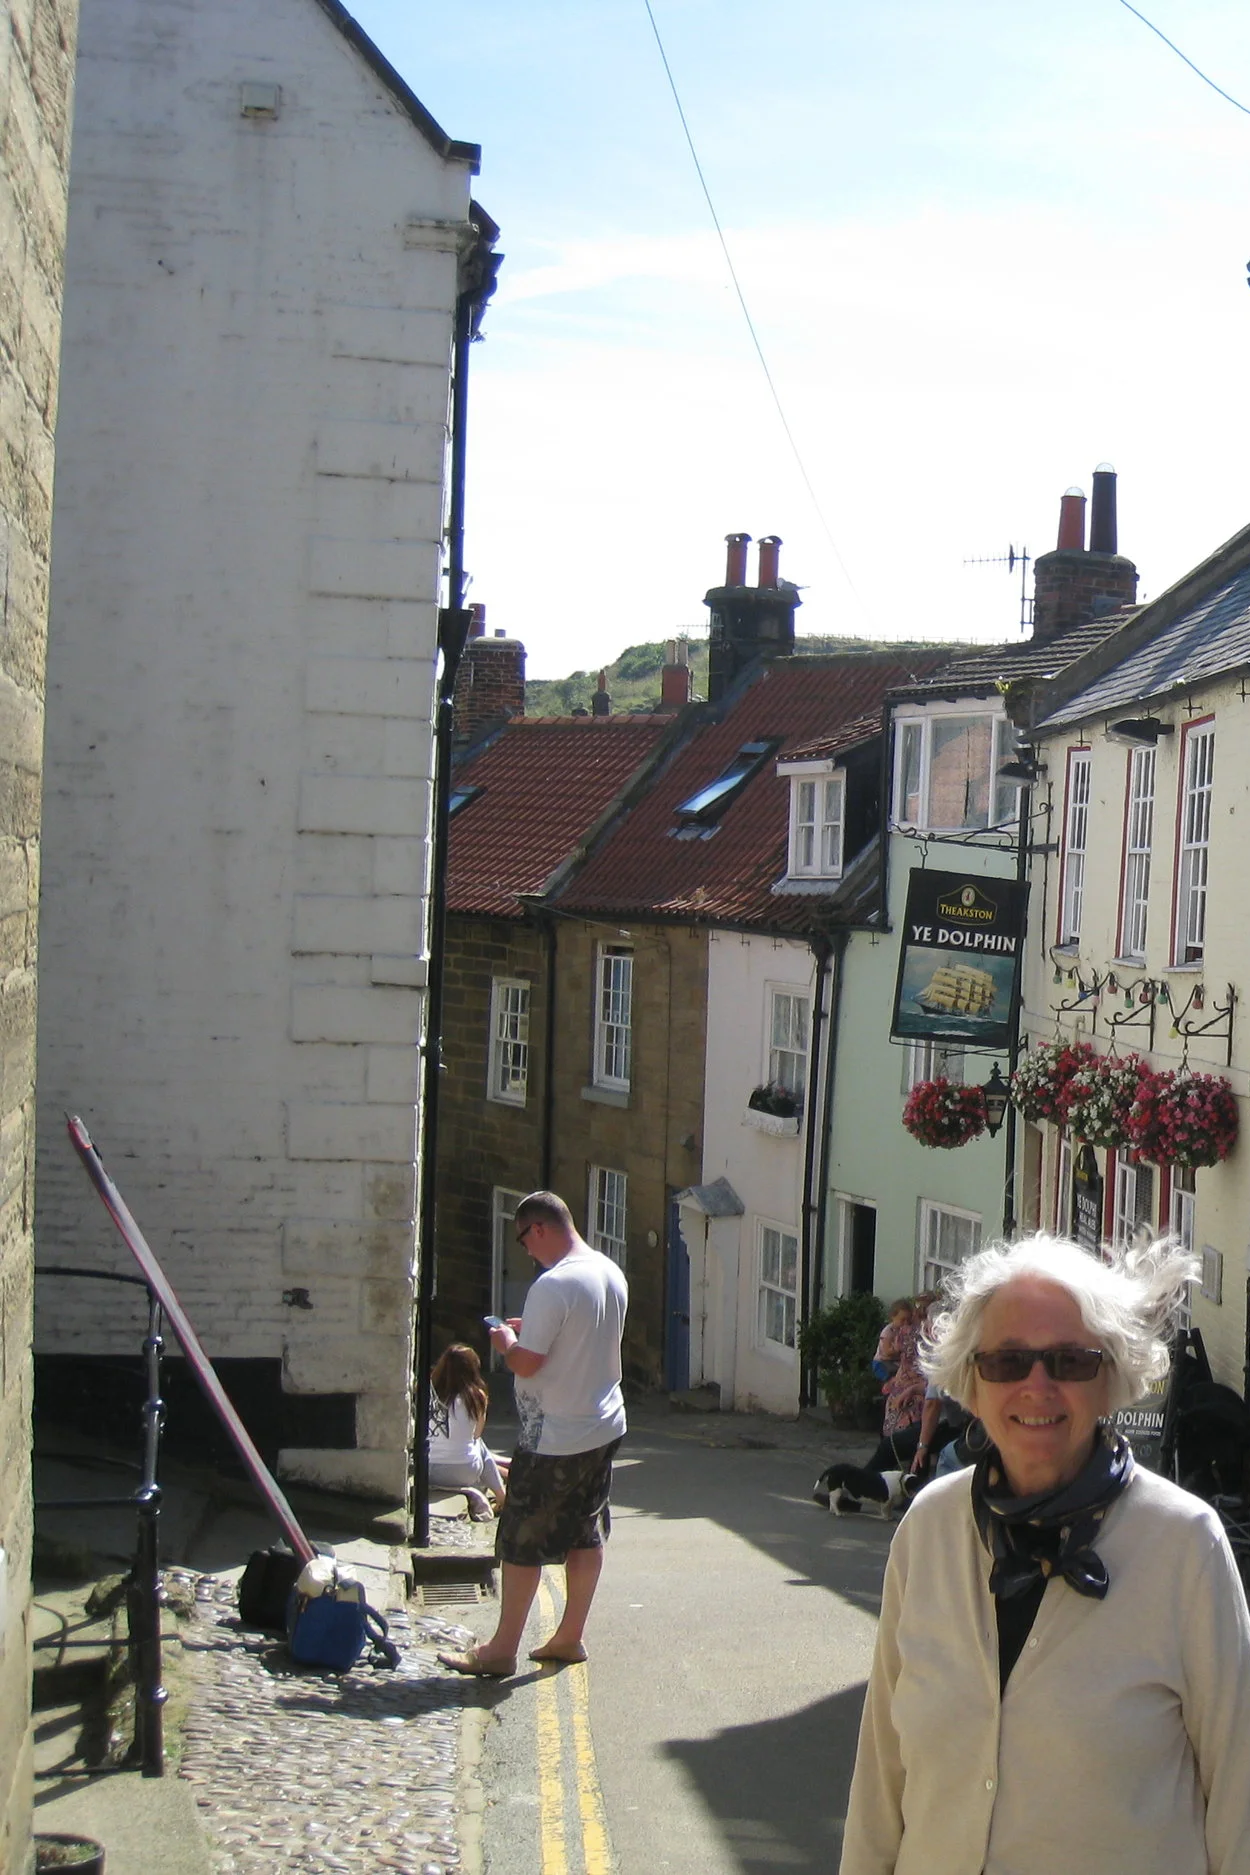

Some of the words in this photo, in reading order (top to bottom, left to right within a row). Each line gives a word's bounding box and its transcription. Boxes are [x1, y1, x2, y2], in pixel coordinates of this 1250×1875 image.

[940, 904, 993, 920] THEAKSTON
[912, 925, 933, 942] YE
[937, 928, 1017, 952] DOLPHIN
[1116, 1411, 1165, 1428] DOLPHIN
